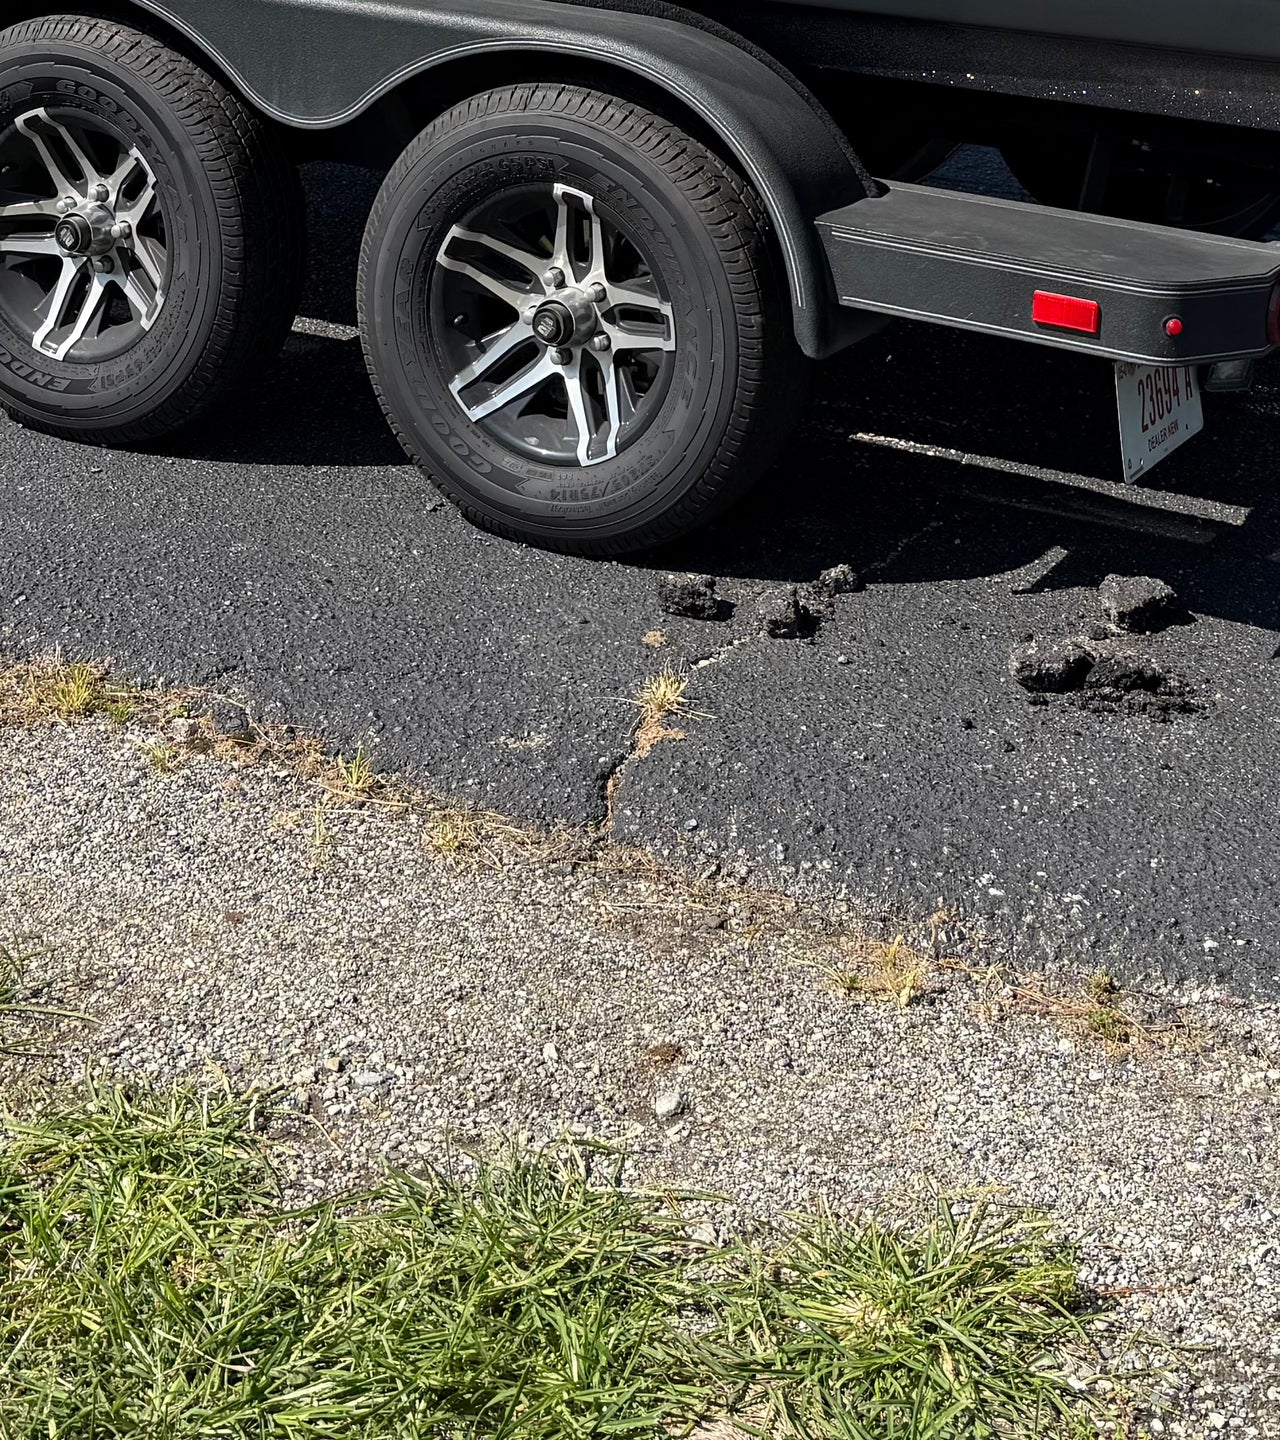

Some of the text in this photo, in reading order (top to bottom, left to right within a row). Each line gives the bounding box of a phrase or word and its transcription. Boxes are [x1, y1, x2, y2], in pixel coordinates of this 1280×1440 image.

[1138, 366, 1180, 433] 23694
[1148, 418, 1180, 452] DEALER NEW
